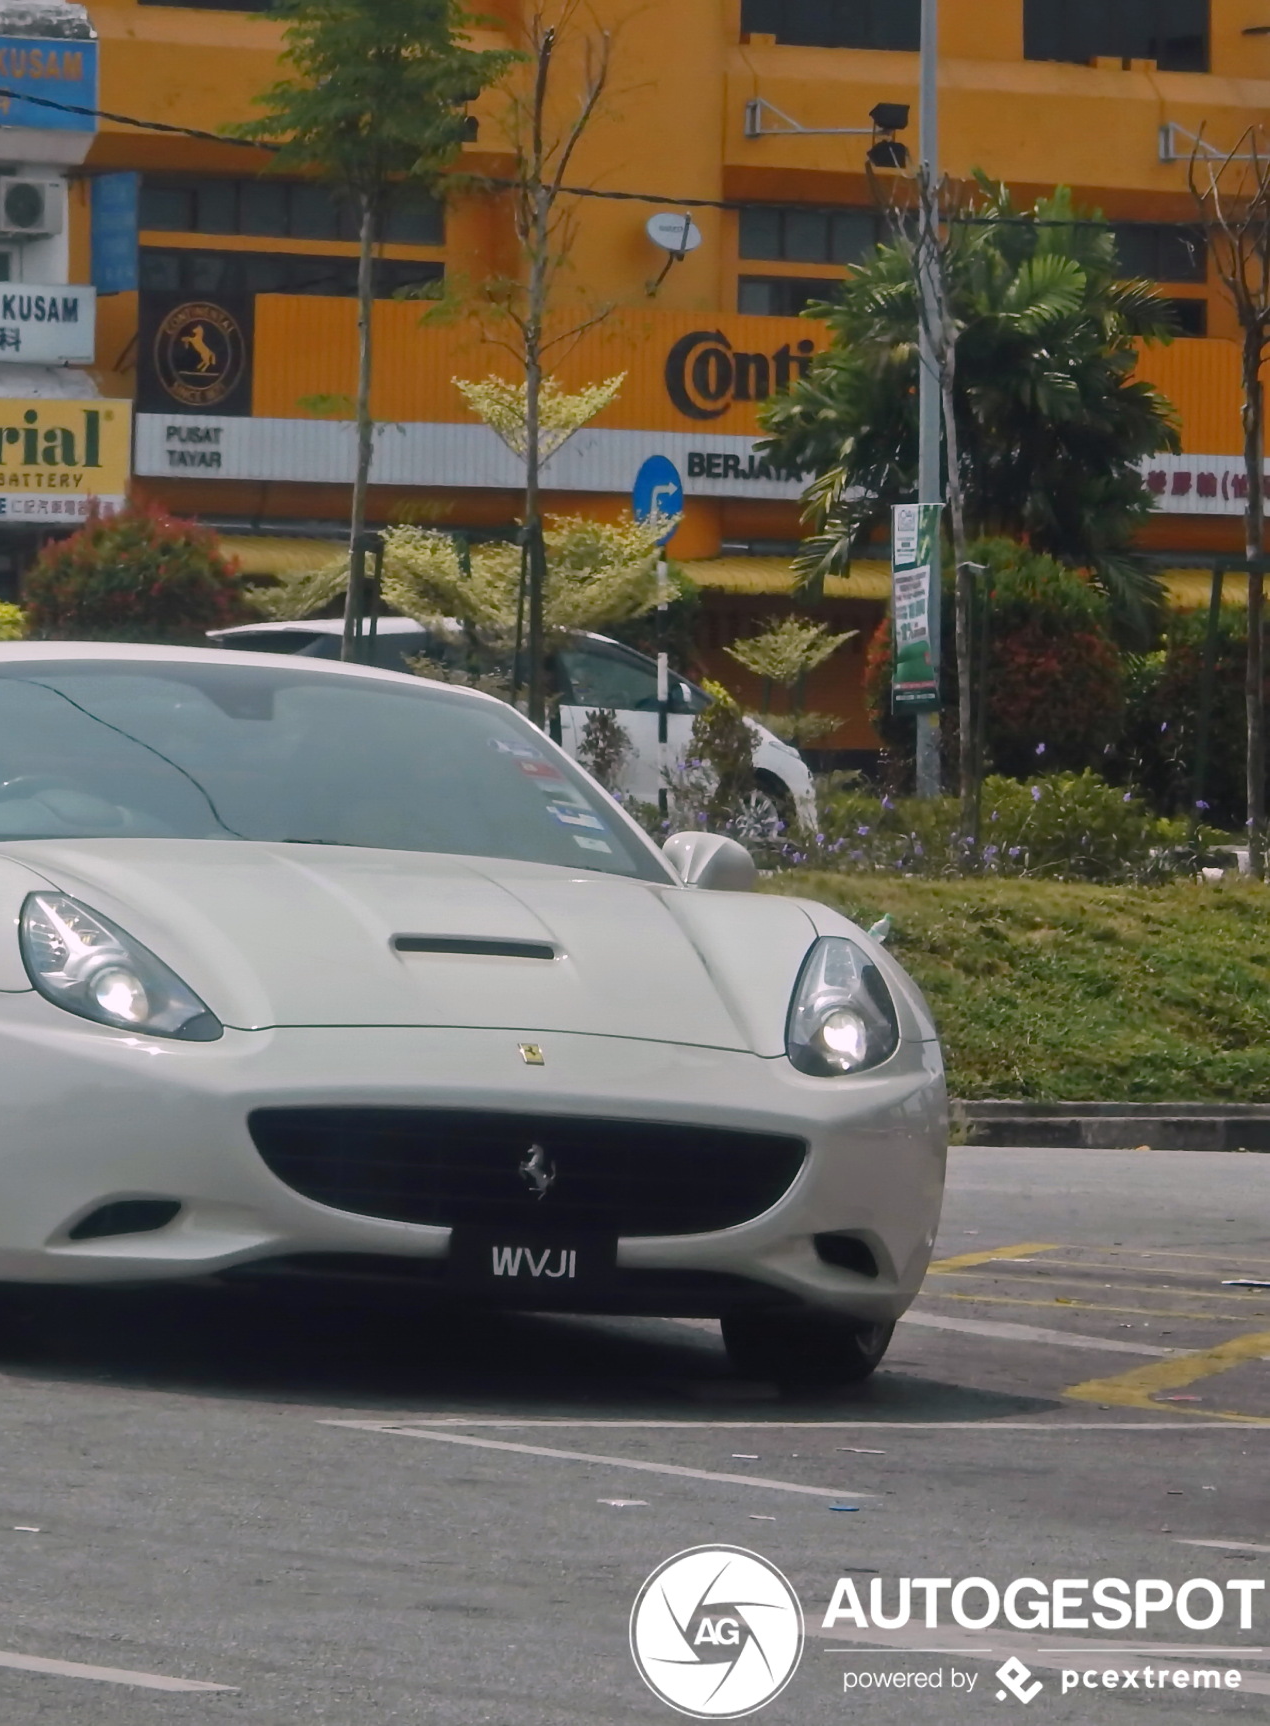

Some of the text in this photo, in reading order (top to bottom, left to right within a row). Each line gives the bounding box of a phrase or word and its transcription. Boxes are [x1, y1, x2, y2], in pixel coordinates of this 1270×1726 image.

[3, 294, 79, 323] KUSAM
[166, 425, 223, 444] PUSAT
[166, 449, 222, 468] TAYAR
